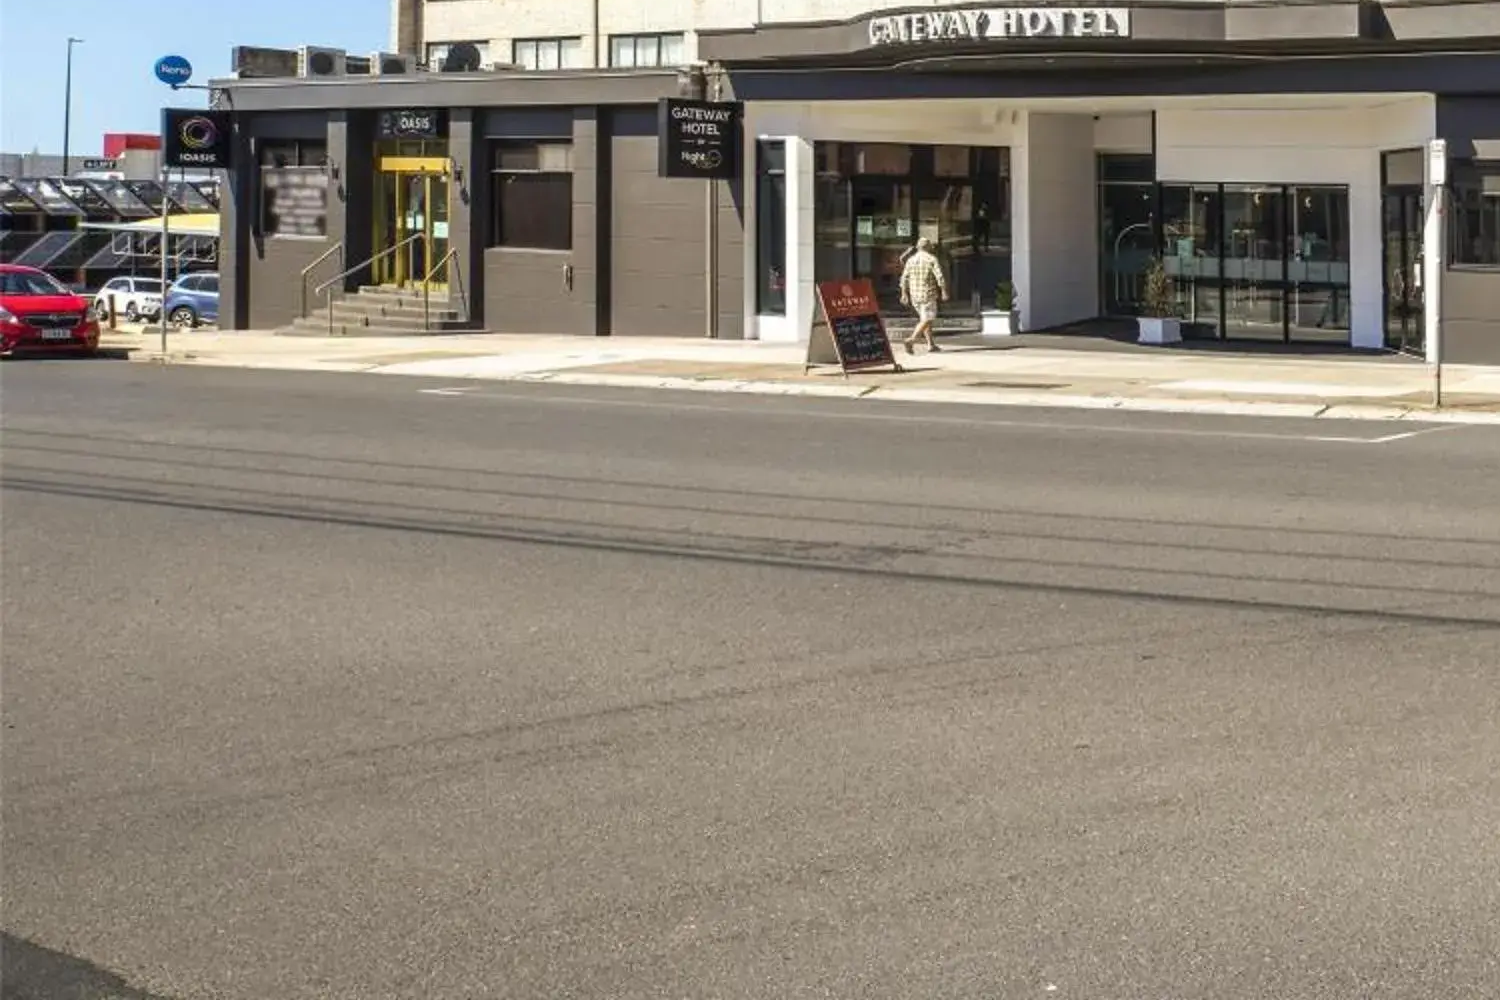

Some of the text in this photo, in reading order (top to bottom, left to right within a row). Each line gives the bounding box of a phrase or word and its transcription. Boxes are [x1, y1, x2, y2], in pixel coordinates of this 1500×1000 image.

[869, 8, 1118, 44] GATEWAY HOTEL
[671, 107, 730, 121] GATEWAY
[400, 116, 430, 129] OASIS
[681, 122, 720, 135] HOTEL
